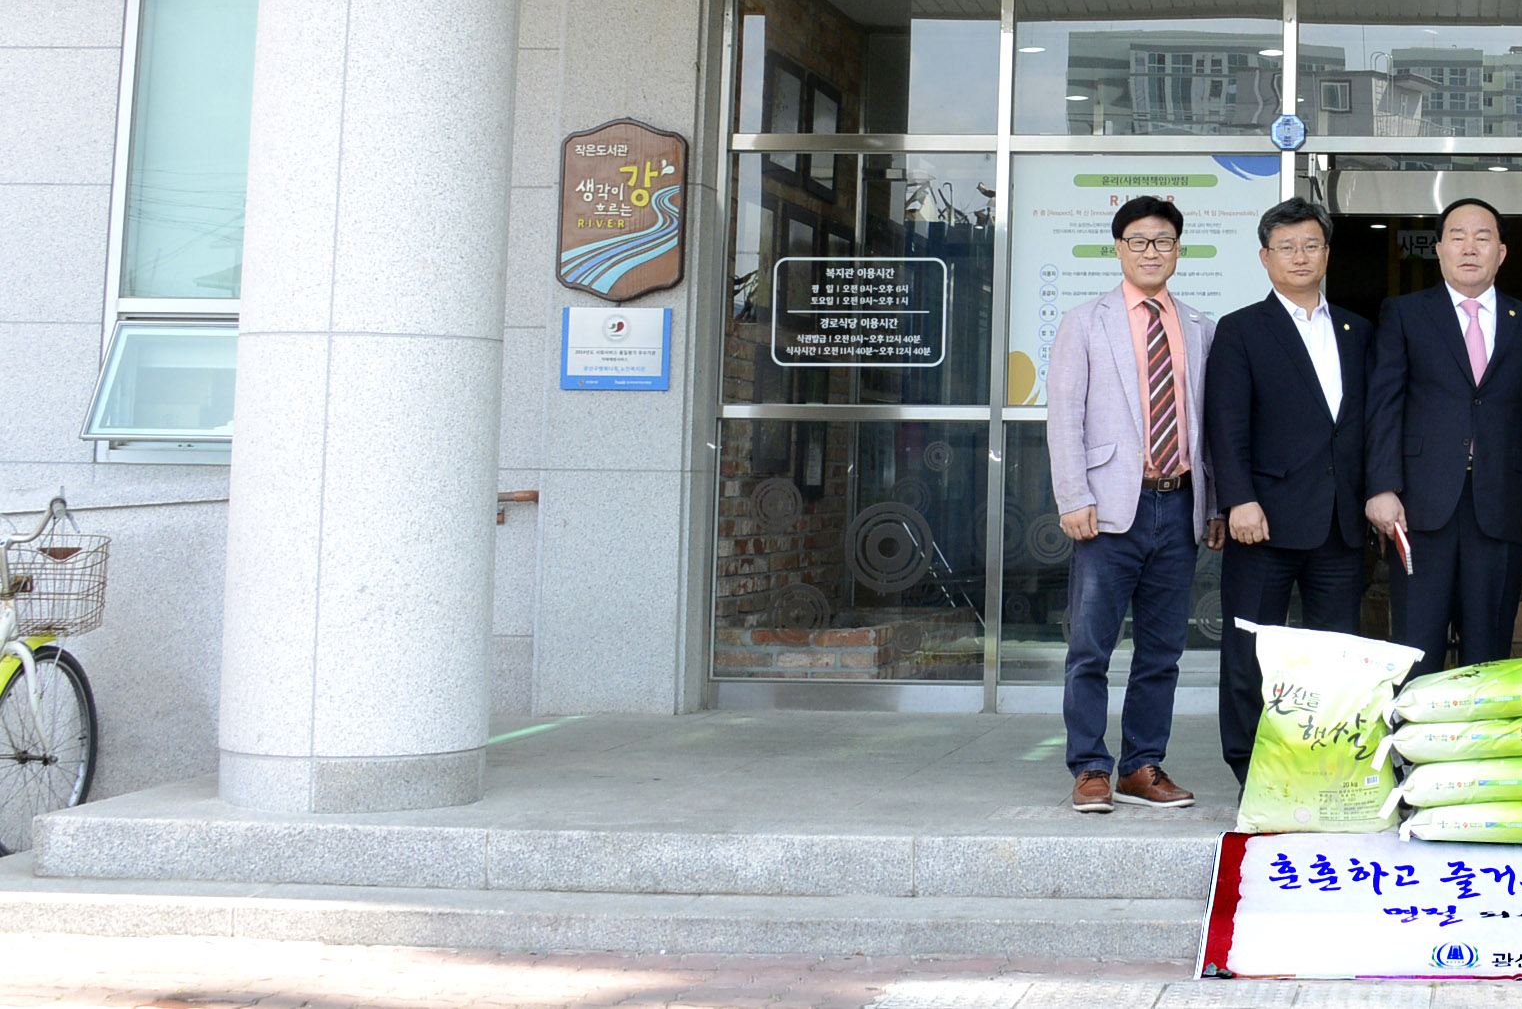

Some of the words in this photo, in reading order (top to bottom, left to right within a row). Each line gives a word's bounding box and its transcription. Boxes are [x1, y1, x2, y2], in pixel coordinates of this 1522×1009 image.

[575, 178, 625, 202] 생각이
[620, 161, 658, 207] 강
[594, 203, 632, 217] 흐르는
[826, 268, 855, 278] 복지관
[857, 268, 895, 278] 이용시간
[811, 297, 834, 306] 토요일
[820, 318, 858, 329] 경로식당
[860, 318, 898, 329] 이용시간
[1269, 853, 1420, 895] 훈훈하고
